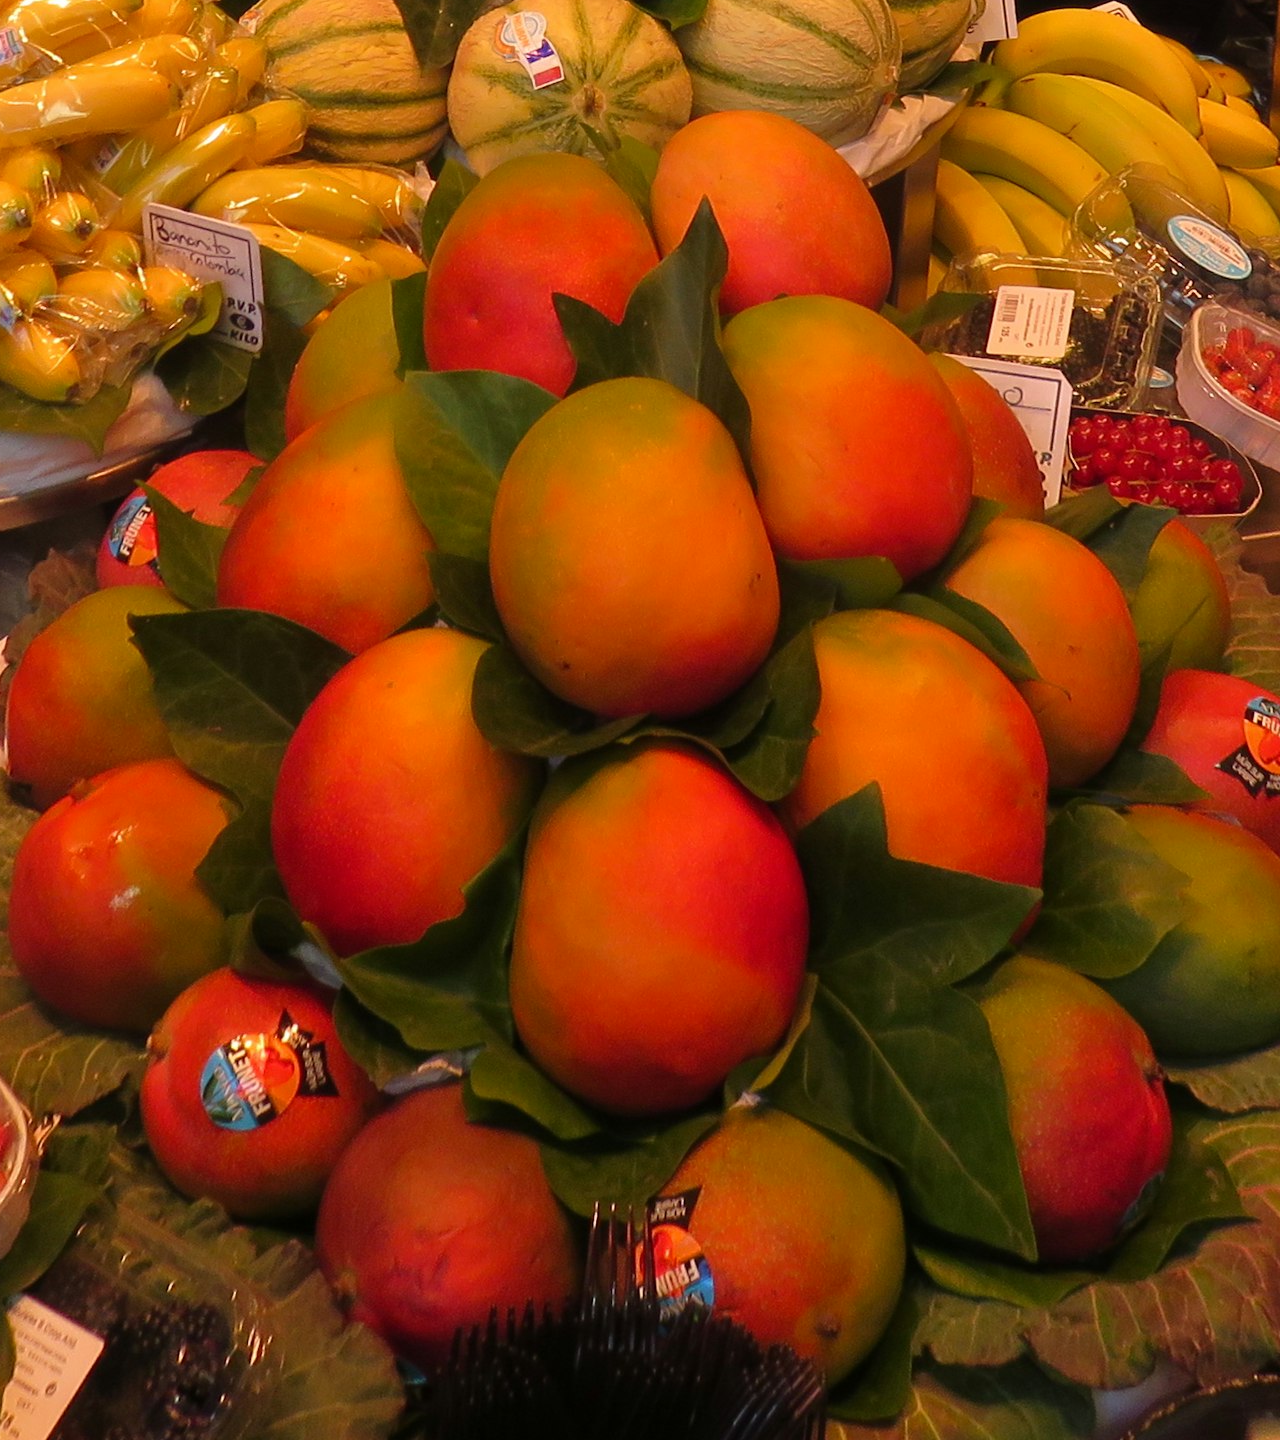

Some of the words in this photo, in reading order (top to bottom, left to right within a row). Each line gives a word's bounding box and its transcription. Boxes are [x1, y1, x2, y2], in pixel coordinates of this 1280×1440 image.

[230, 329, 259, 346] KILO
[119, 504, 152, 557] FRUNET
[227, 1049, 272, 1118] FRUNET
